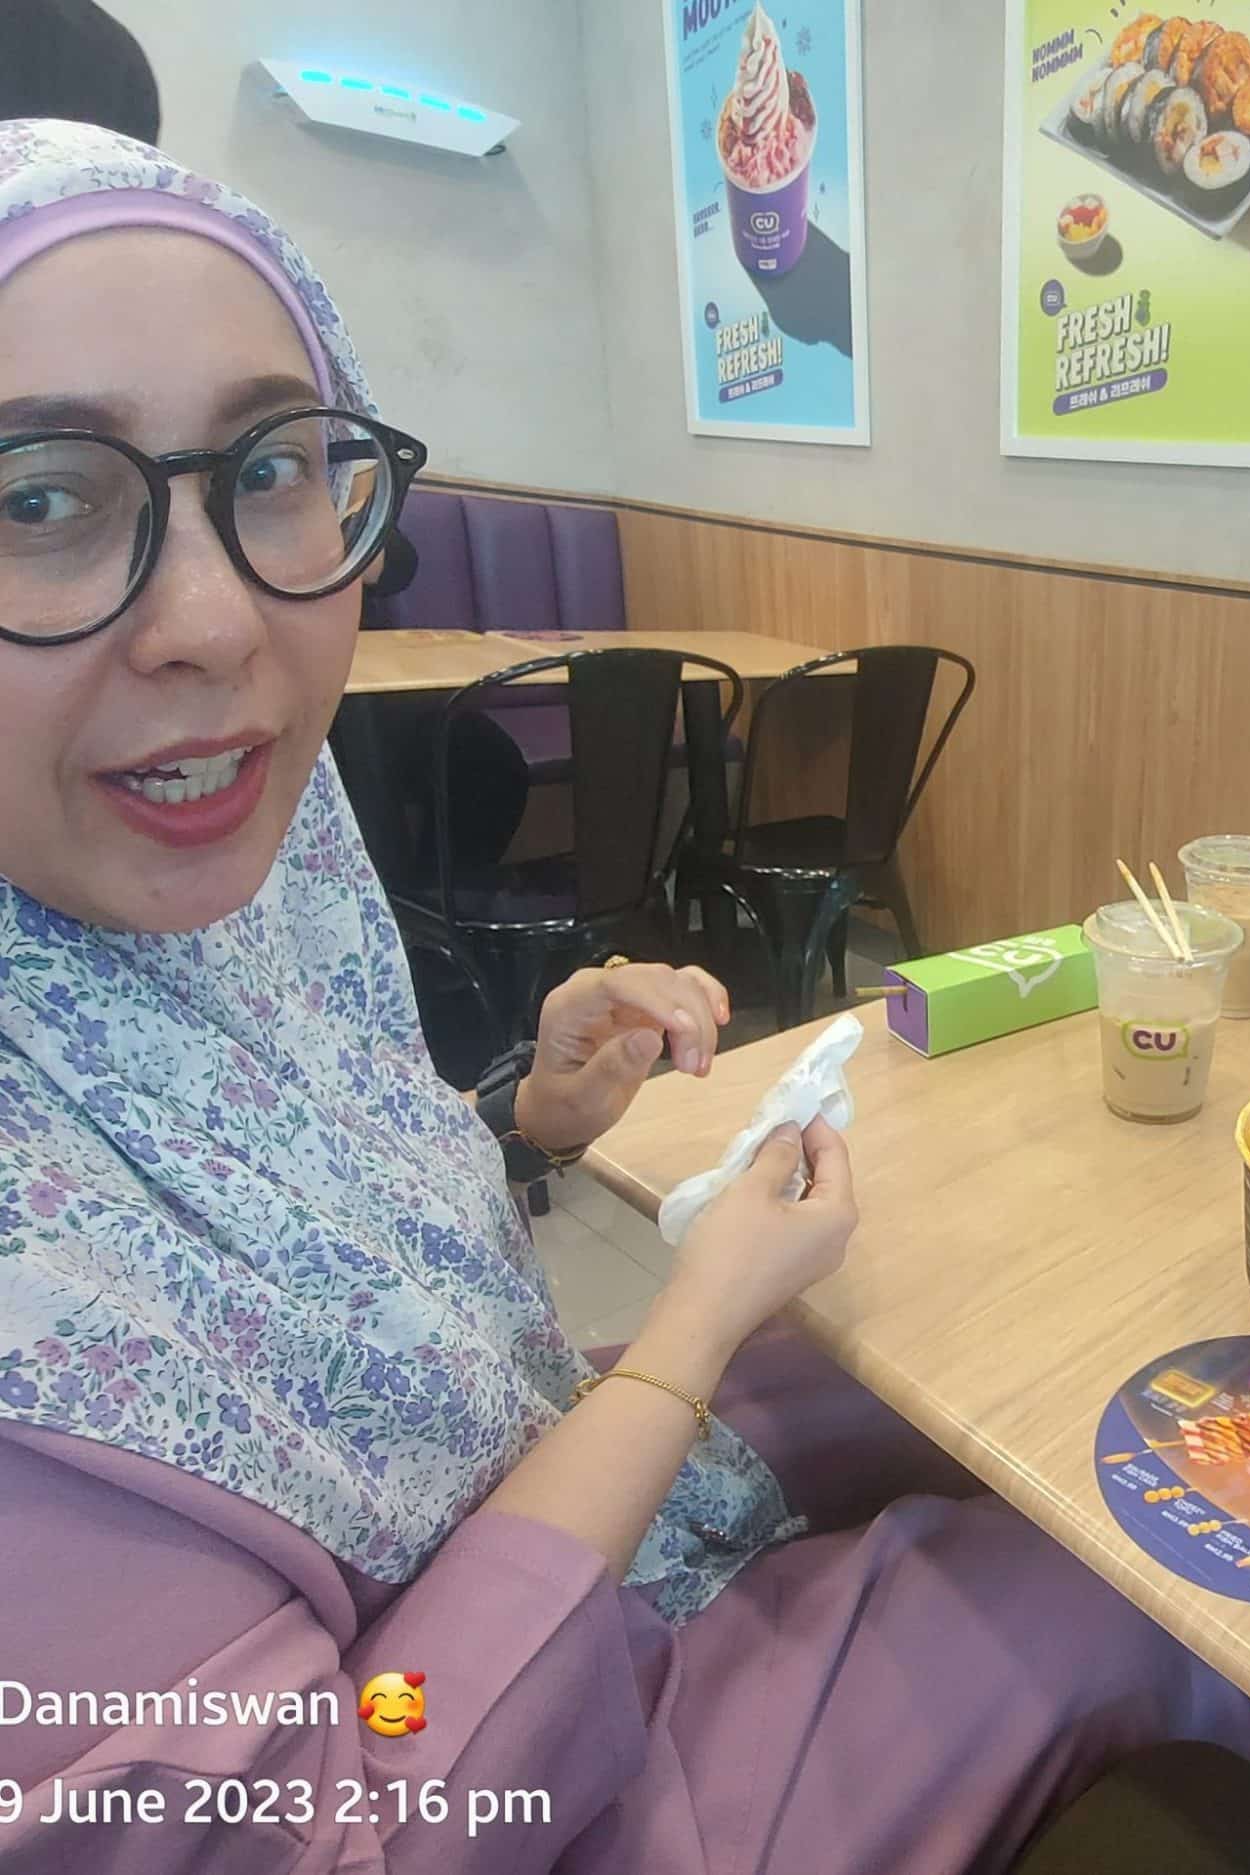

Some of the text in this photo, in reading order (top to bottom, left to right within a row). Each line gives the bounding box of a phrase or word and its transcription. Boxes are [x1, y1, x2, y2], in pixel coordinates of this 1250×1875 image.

[716, 314, 760, 357] FRESH
[1056, 293, 1133, 353] FRESH
[717, 336, 783, 386] REFRESH!
[1055, 321, 1171, 392] REFRESH!
[1133, 1030, 1177, 1051] CU
